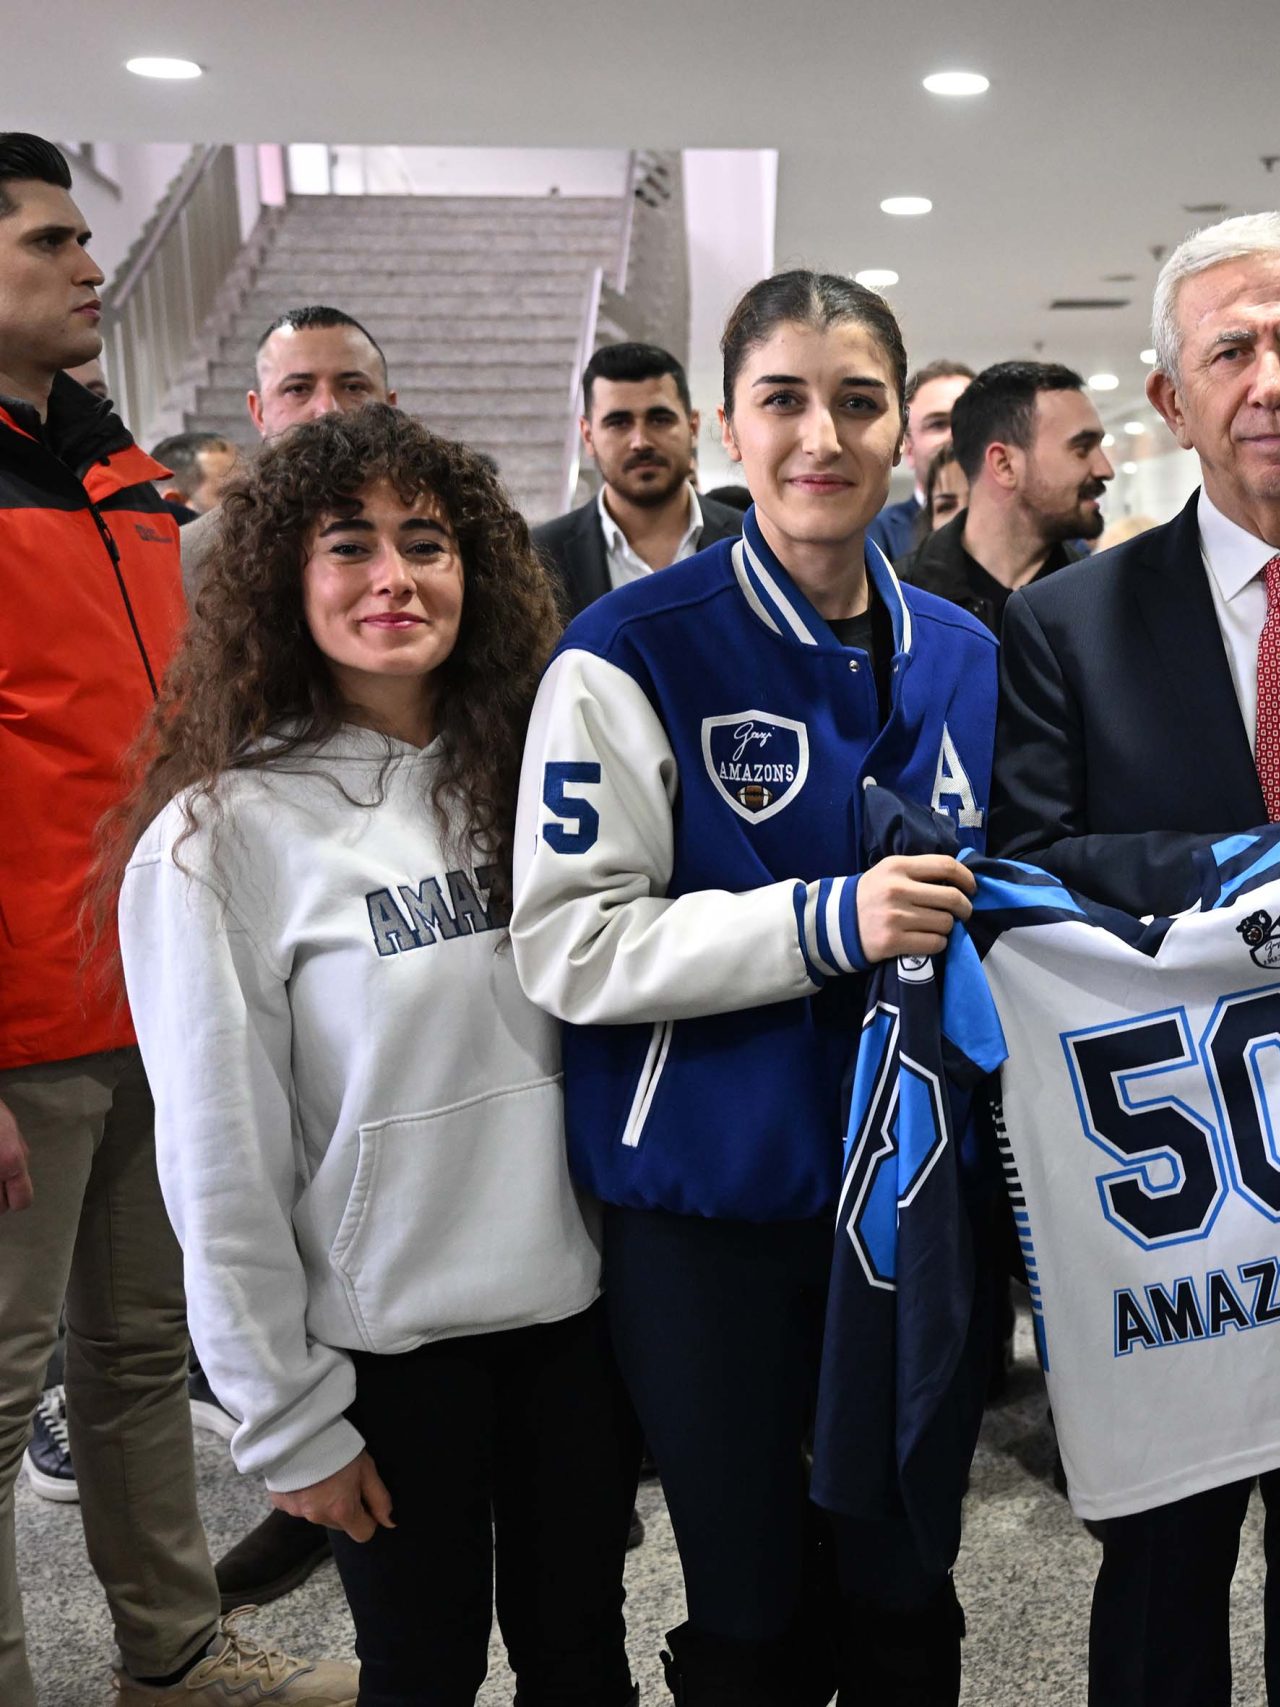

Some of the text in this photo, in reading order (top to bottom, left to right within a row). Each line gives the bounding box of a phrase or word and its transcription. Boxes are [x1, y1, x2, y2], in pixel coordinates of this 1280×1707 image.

[542, 761, 601, 854] 5
[719, 760, 795, 783] AMAZONS
[930, 721, 984, 828] A
